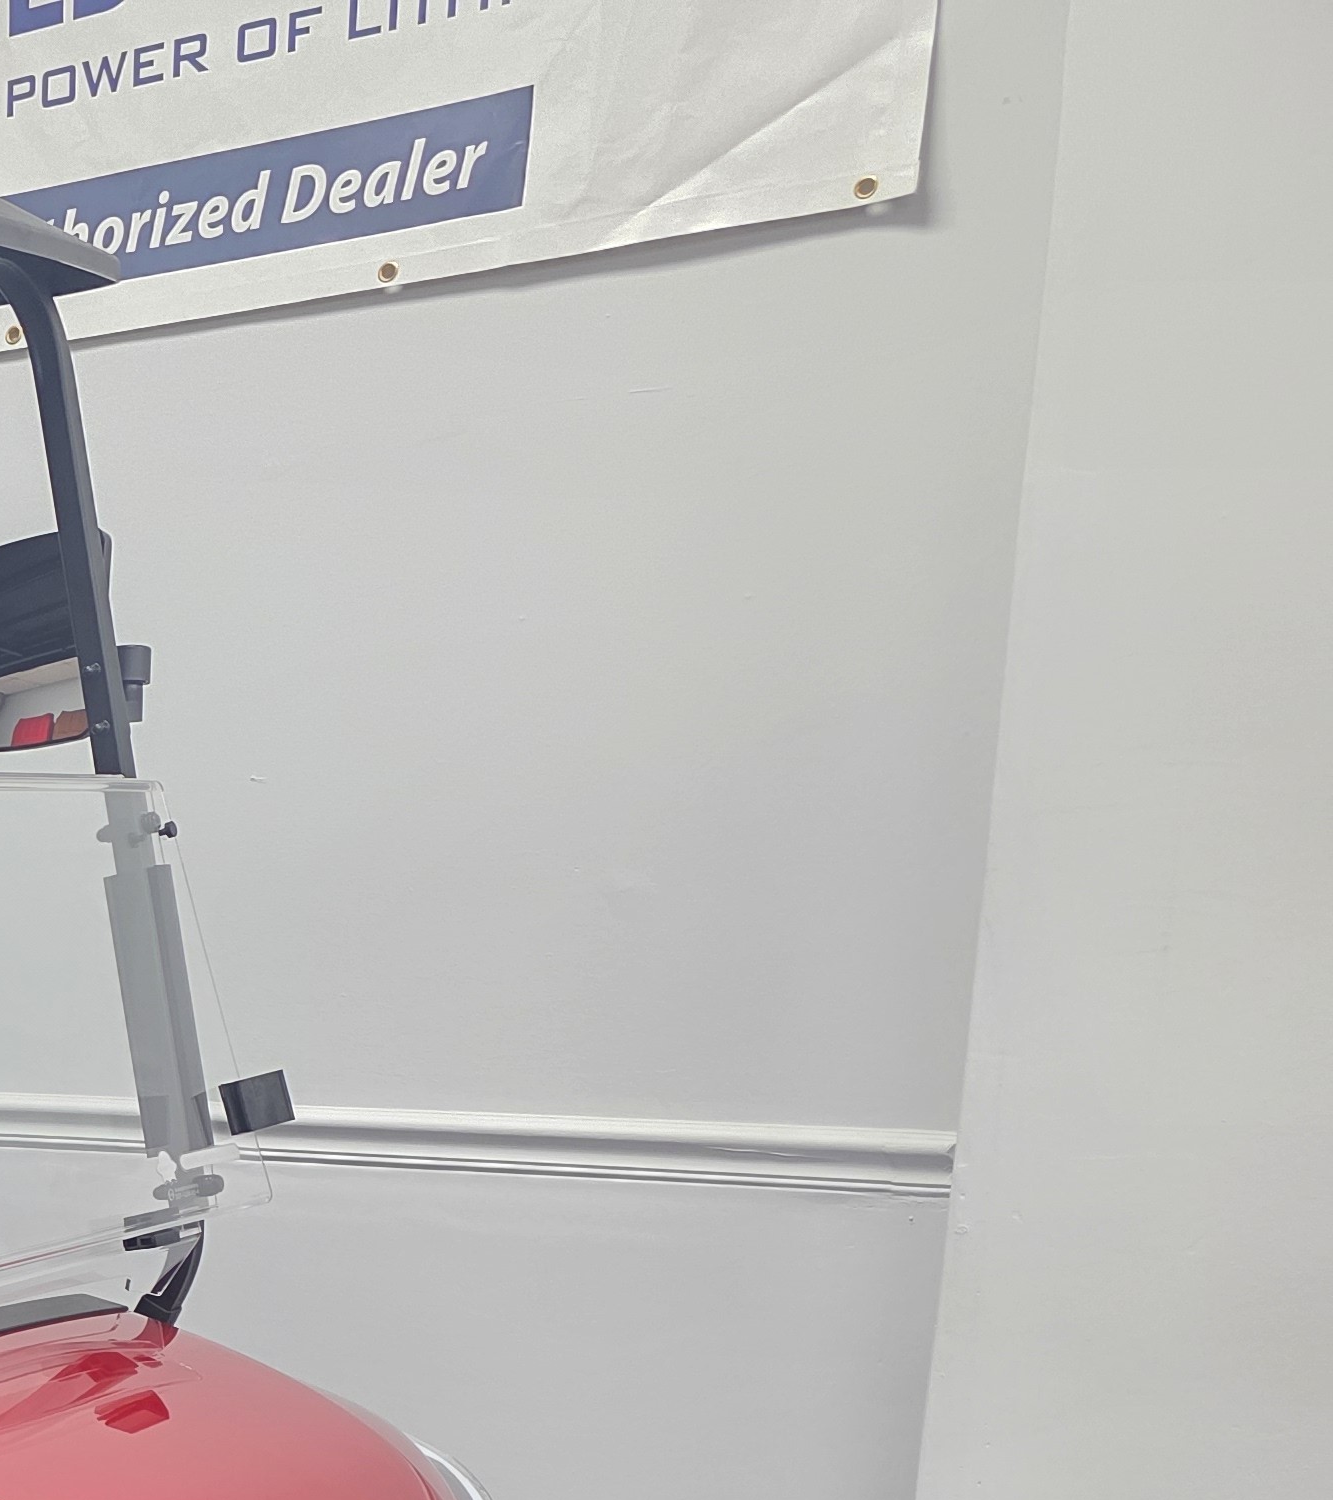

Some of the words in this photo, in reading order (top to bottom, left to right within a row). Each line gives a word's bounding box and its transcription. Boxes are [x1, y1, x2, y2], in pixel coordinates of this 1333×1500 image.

[6, 33, 209, 118] POWER
[236, 6, 323, 63] OF
[46, 170, 272, 255] horized
[281, 137, 488, 224] Dealer
